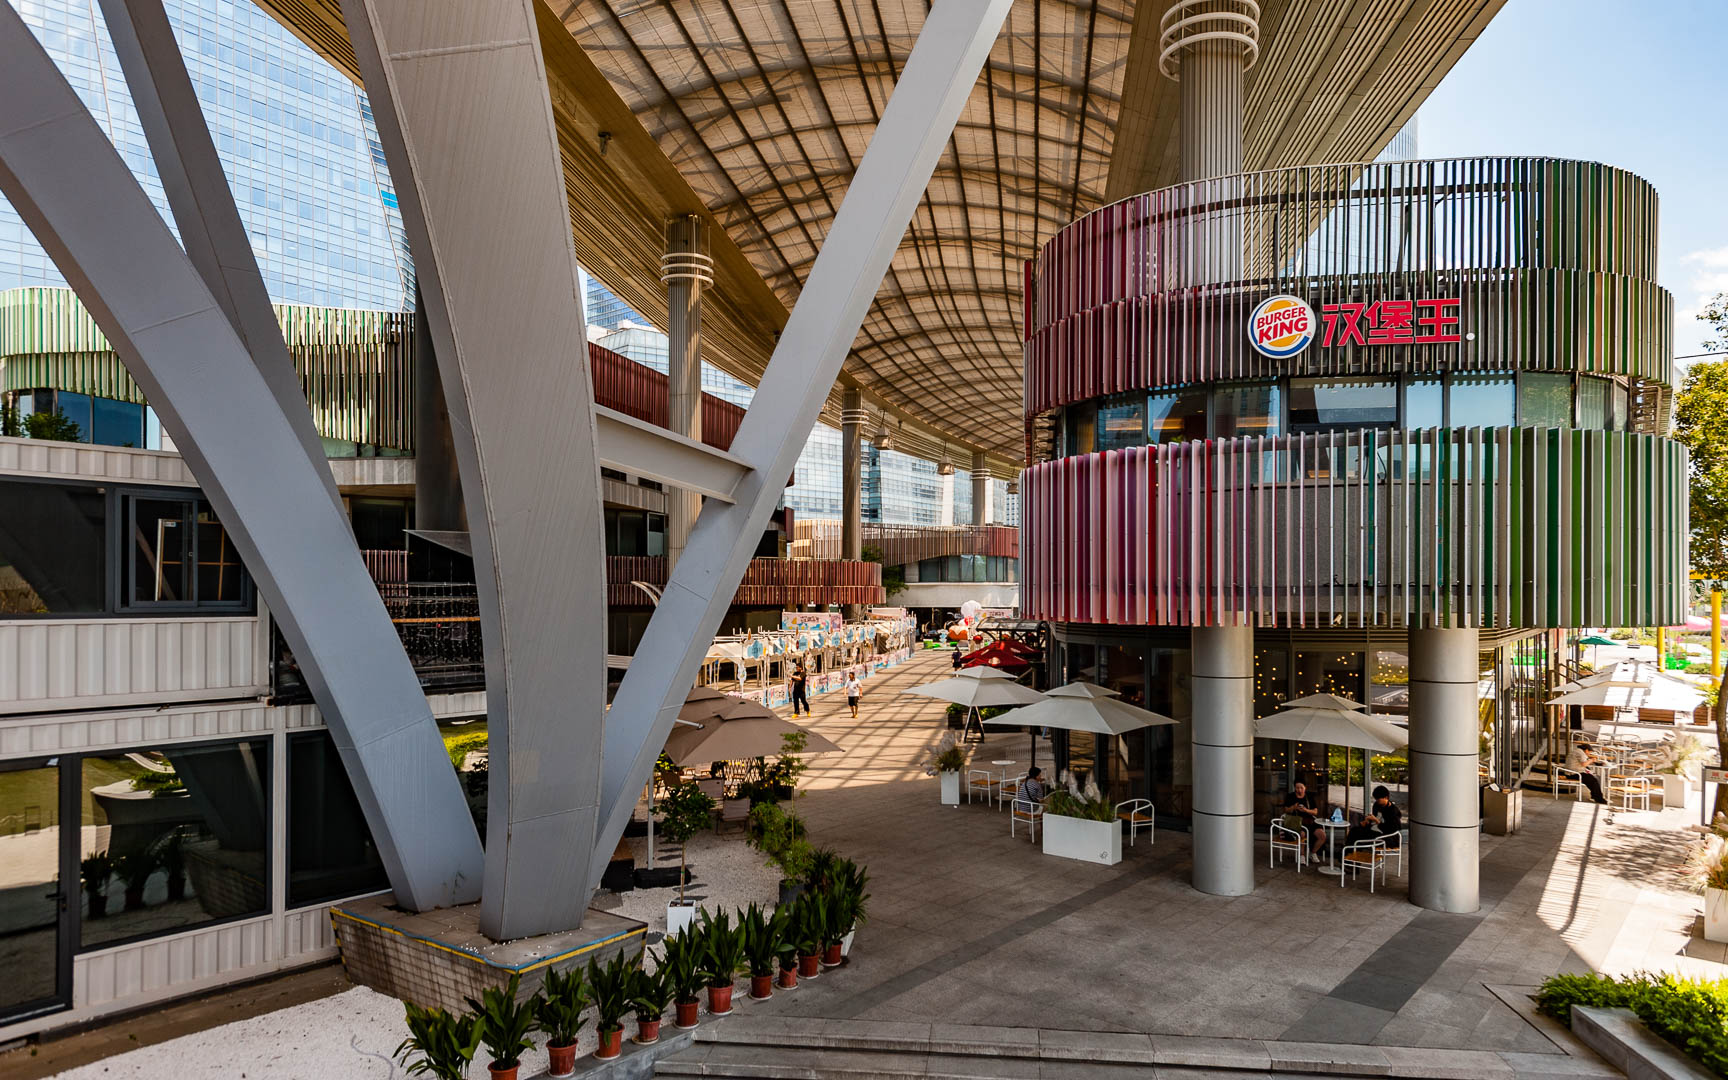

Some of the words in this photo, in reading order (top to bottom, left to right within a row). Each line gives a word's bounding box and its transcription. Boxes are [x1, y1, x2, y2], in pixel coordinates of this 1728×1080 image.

[1257, 306, 1306, 329] BURGER
[1258, 316, 1308, 344] KING
[1322, 298, 1461, 347] 汉堡王
